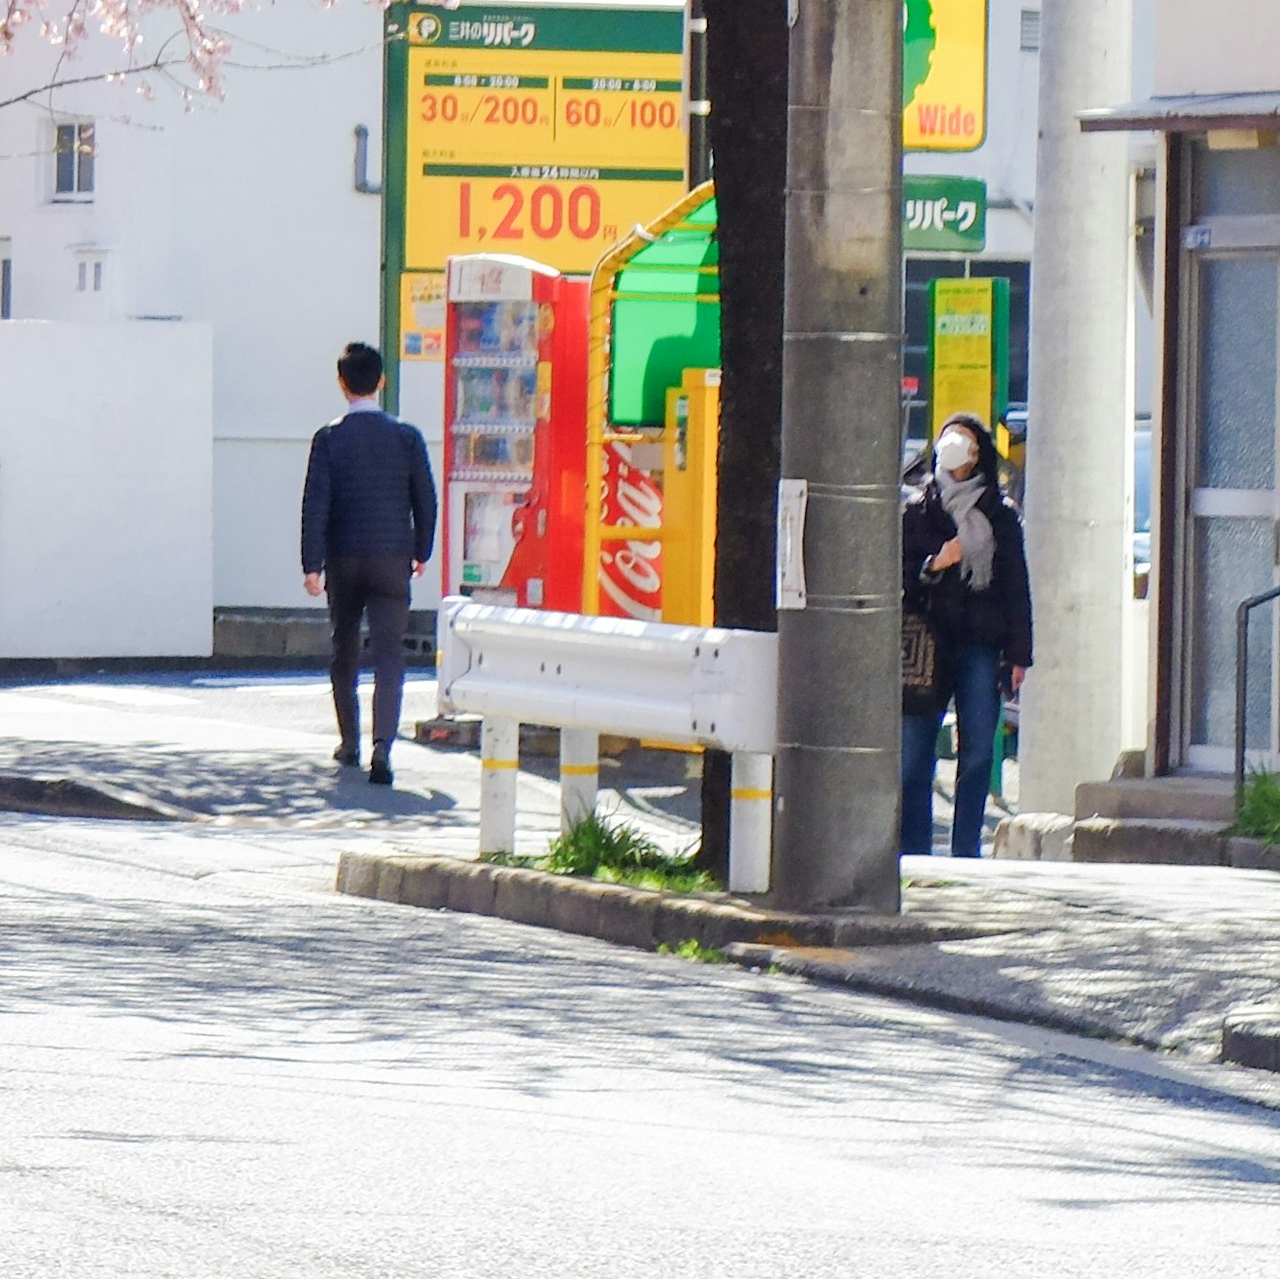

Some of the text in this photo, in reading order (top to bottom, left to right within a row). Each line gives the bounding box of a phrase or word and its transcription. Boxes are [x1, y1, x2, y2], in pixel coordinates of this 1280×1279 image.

[448, 21, 536, 47] 三井のリパーク
[917, 103, 976, 137] Wide
[905, 197, 977, 232] リパーク
